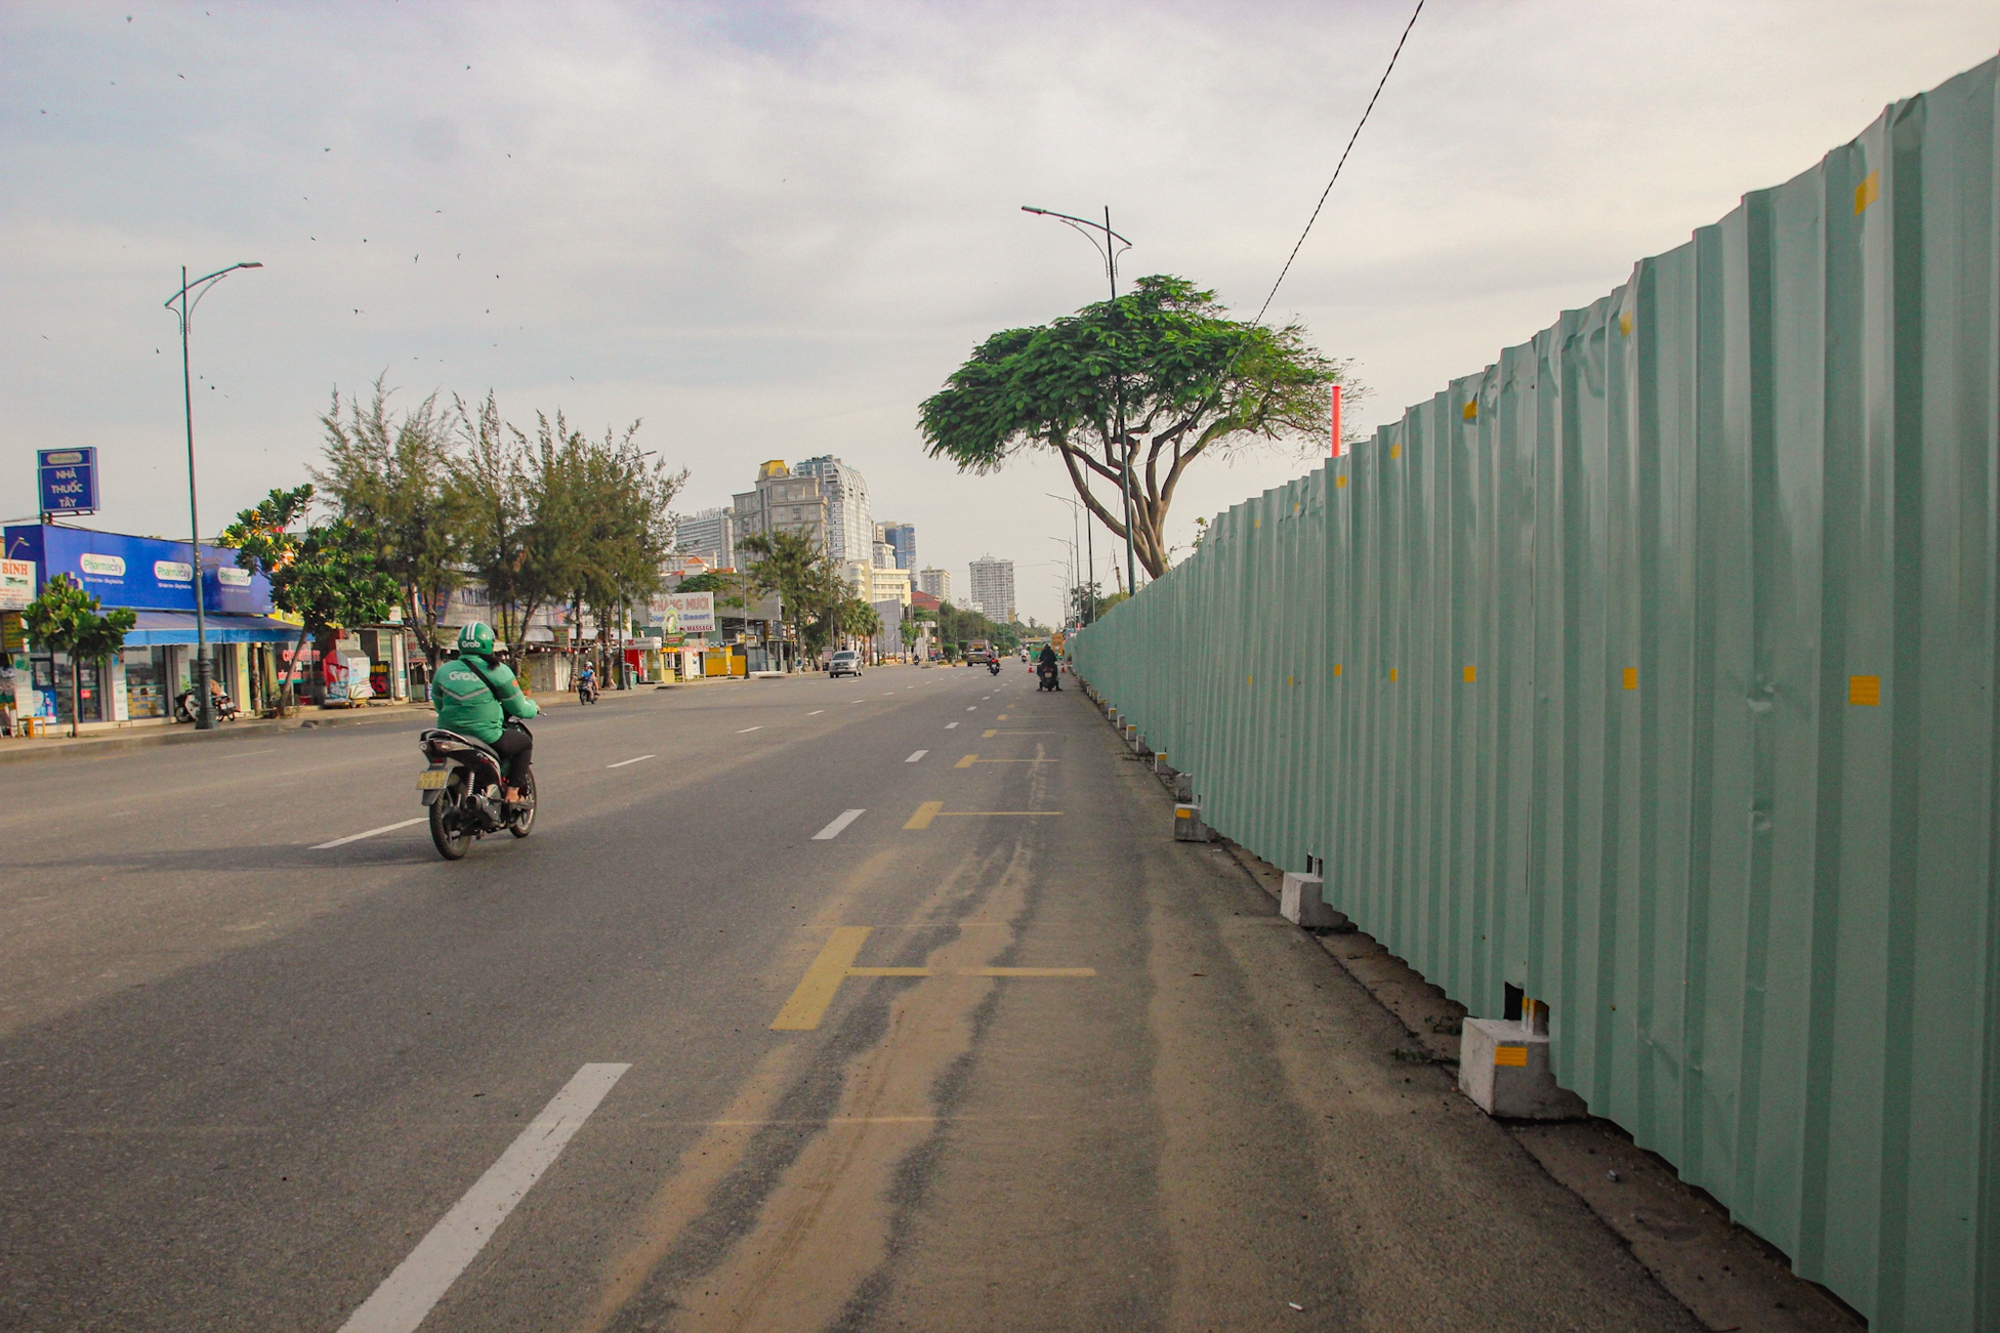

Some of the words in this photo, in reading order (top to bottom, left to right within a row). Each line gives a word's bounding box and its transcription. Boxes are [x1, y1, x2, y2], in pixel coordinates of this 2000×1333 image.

[51, 480, 83, 494] THUỐC
[59, 496, 77, 508] TÂY
[83, 559, 123, 575] Pharmacity
[157, 565, 191, 580] Pharmacity
[220, 571, 249, 585] Pharmacity
[683, 613, 711, 621] Resort
